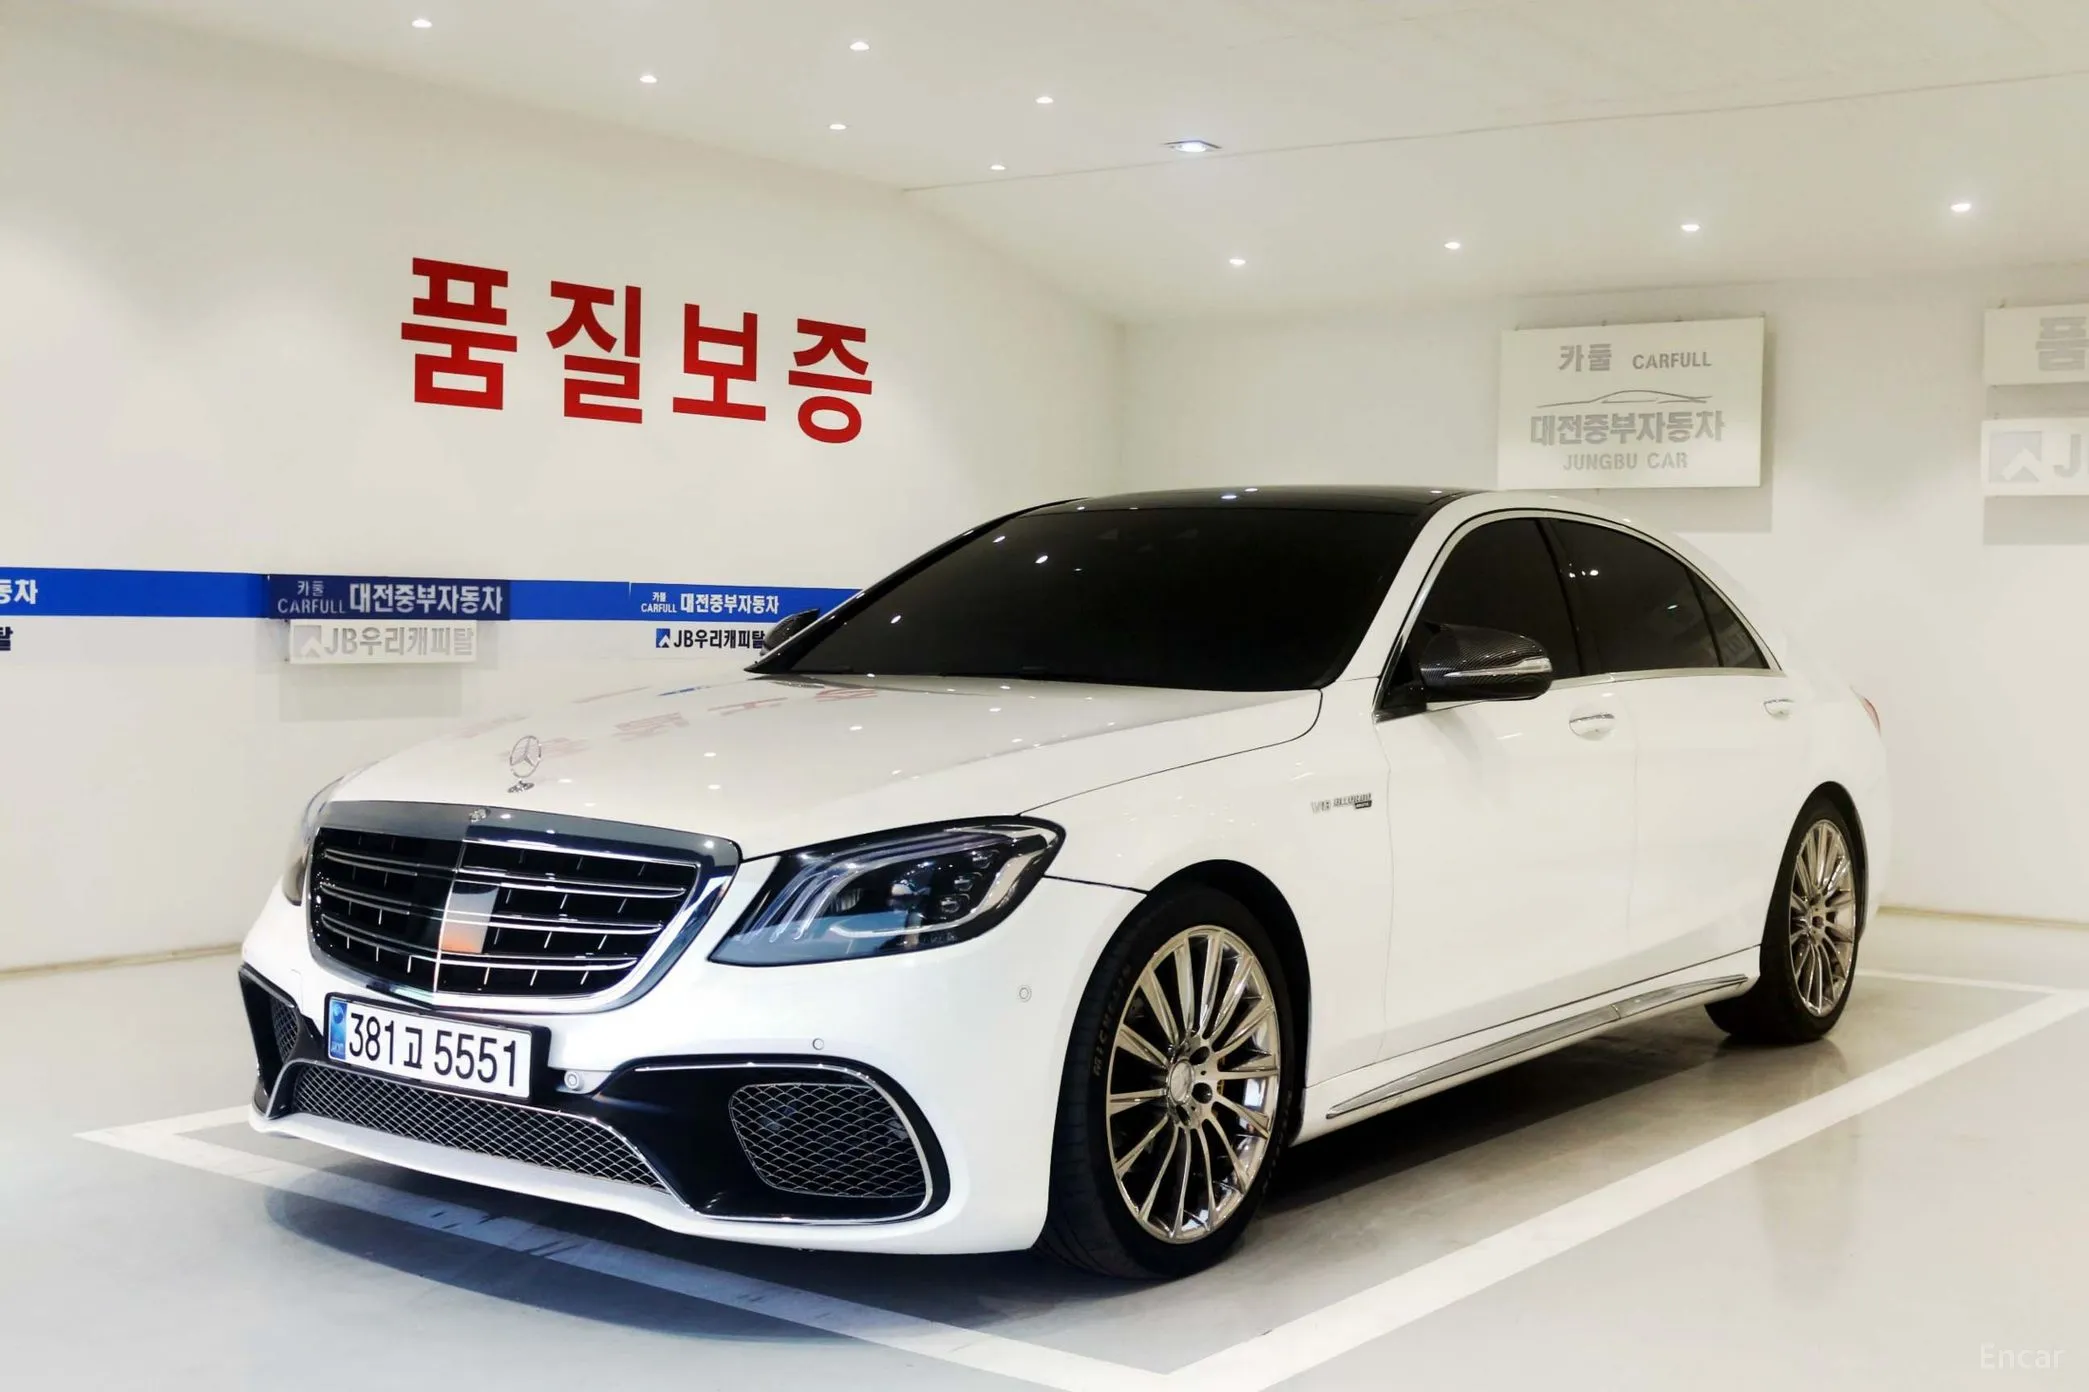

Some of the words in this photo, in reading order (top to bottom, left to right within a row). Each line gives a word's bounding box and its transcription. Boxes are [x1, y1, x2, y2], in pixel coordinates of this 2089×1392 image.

[401, 257, 872, 443] 품질보증
[1632, 352, 1712, 370] CARFULL
[1530, 410, 1725, 446] 대전중부자동차
[1563, 453, 1638, 471] JUNGBU
[1647, 452, 1688, 469] CAR
[2053, 434, 2089, 478] J
[277, 598, 346, 614] CARFULL
[350, 583, 503, 614] 대전중부자동차
[641, 602, 677, 614] CARFULL
[680, 593, 779, 614] 대전중부자동차
[325, 626, 474, 656] JB우리캐피탈
[674, 628, 765, 649] JB우리캐피탈
[434, 1030, 516, 1087] 5551
